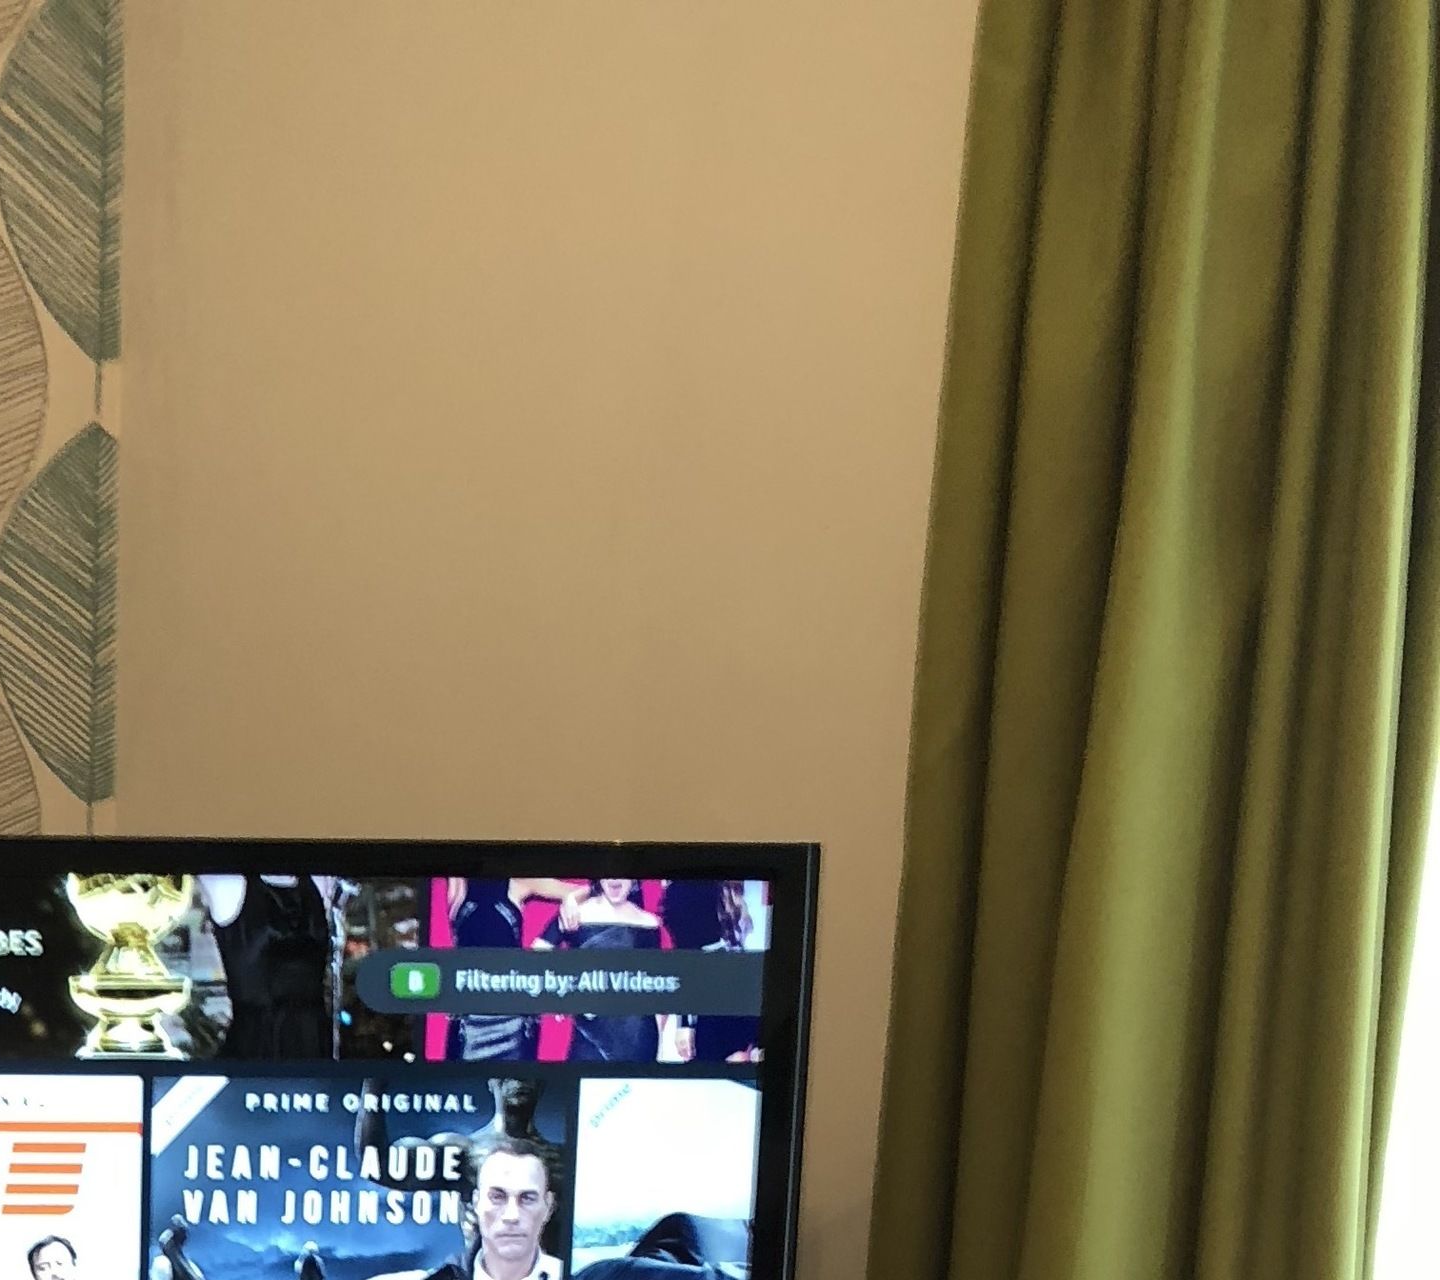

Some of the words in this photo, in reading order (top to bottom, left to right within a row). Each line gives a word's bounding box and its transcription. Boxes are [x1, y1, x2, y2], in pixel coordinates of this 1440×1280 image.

[455, 969, 542, 998] Filtering
[544, 969, 574, 997] by:
[575, 970, 606, 993] All
[609, 971, 680, 994] Videos
[245, 1093, 330, 1112] PRIME
[343, 1093, 477, 1113] ORIGINAL
[184, 1145, 462, 1181] JEAN-CLAUDE
[183, 1189, 258, 1225] VAN
[281, 1190, 461, 1225] JOHNSON
